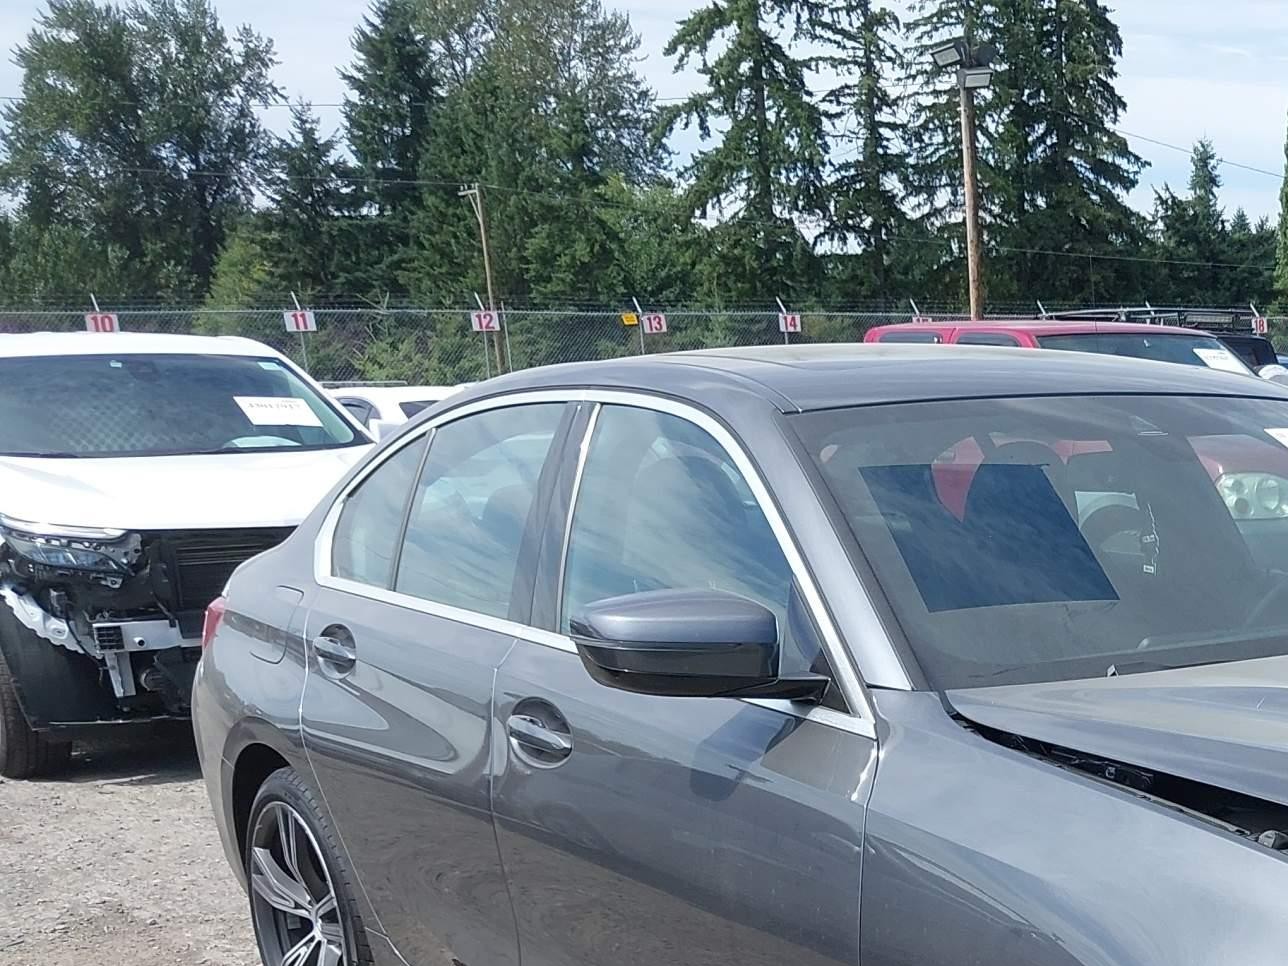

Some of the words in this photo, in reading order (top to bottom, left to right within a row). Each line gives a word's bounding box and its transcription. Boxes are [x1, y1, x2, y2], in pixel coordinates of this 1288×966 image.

[91, 315, 114, 332] 10
[291, 312, 308, 331] 11
[475, 313, 496, 330] 12
[646, 315, 663, 331] 13
[784, 316, 798, 331] 14
[1254, 319, 1265, 333] 18
